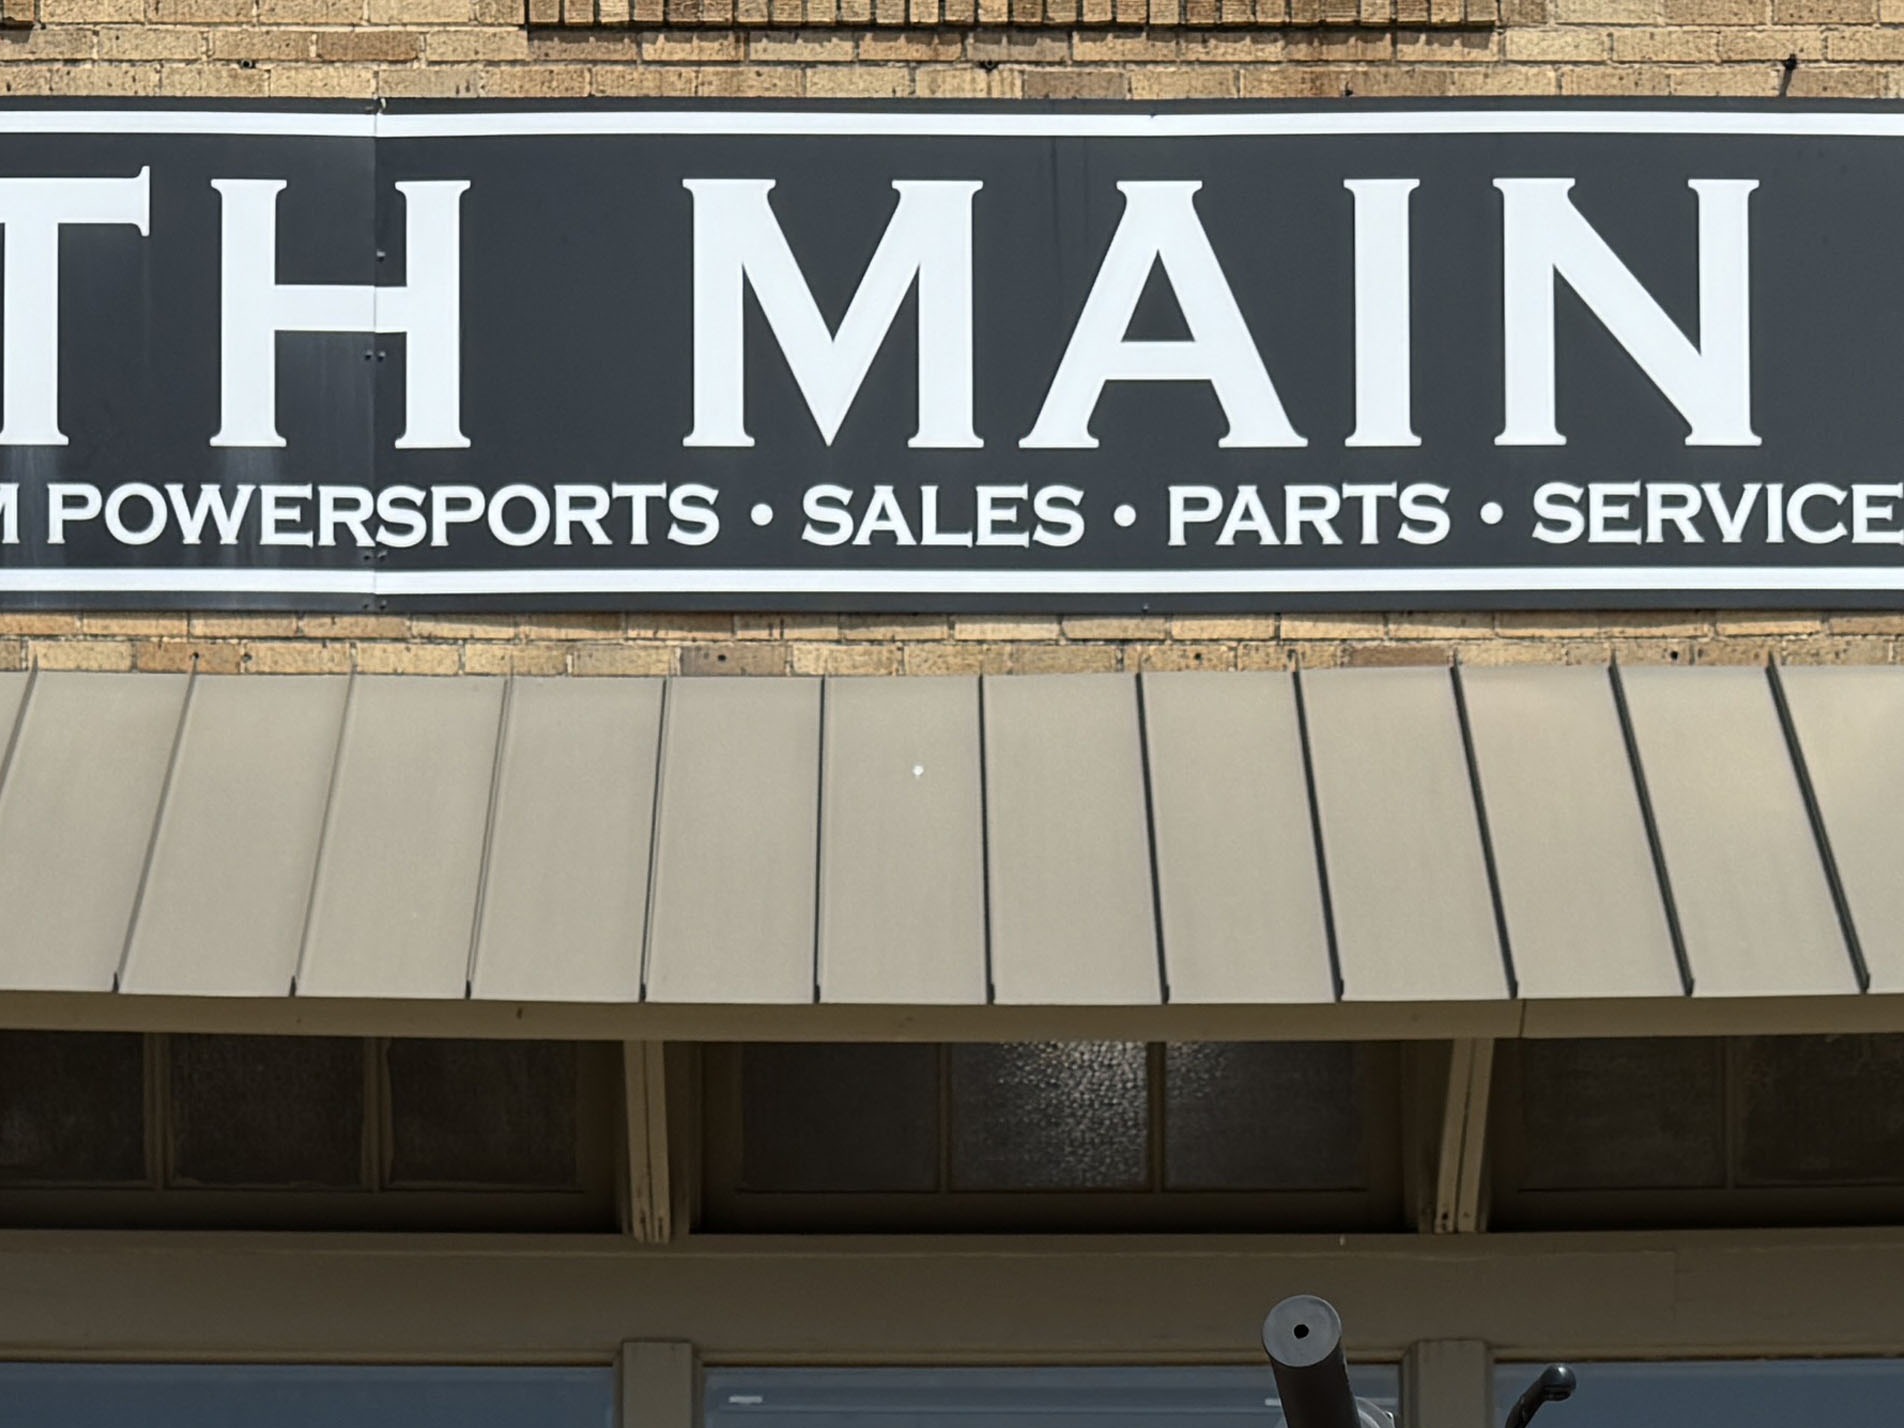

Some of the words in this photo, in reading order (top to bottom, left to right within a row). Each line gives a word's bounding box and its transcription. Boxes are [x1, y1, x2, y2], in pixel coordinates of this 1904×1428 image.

[683, 178, 1763, 449] MAIN
[47, 482, 720, 548] POWERSPORTS
[801, 483, 1085, 548] SALES
[1168, 481, 1451, 546] PARTS
